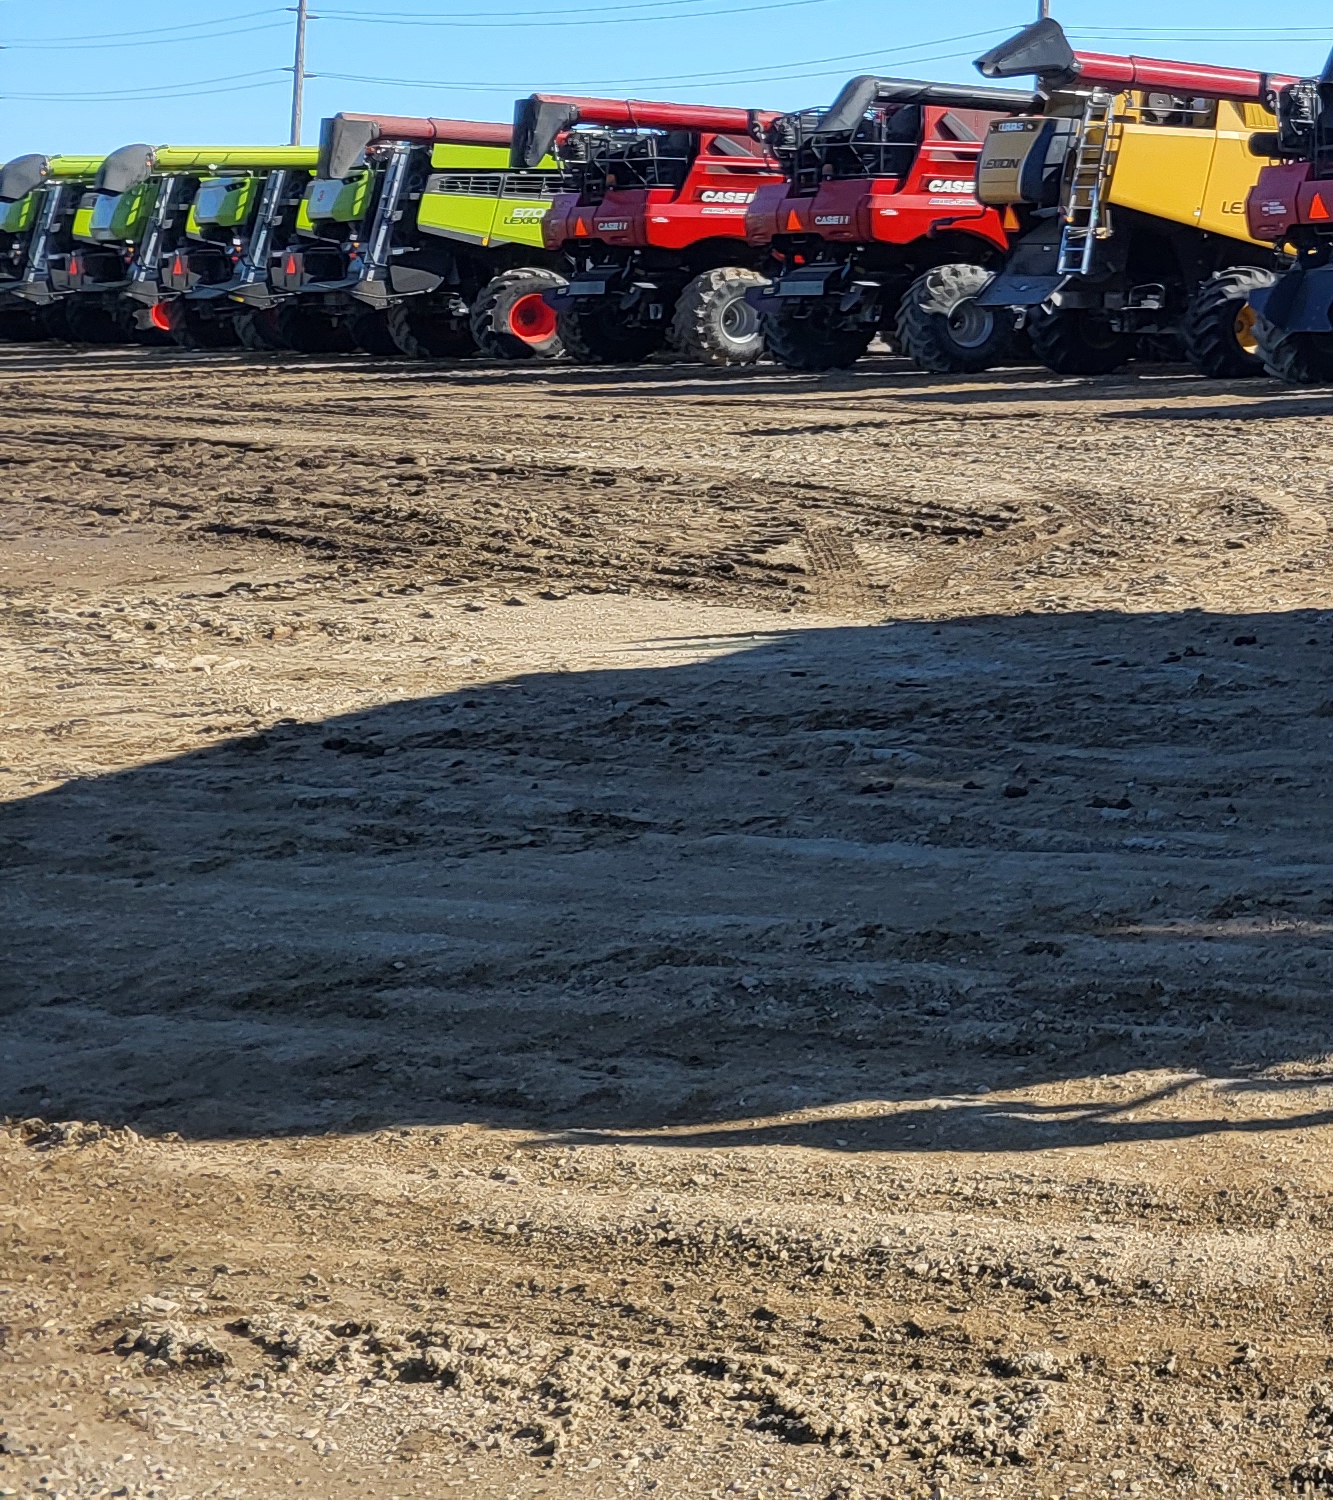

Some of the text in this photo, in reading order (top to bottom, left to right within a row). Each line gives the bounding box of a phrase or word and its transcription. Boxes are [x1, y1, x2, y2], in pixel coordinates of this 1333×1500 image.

[512, 207, 547, 218] 870
[1221, 201, 1247, 214] LE
[504, 216, 543, 225] LEXIO
